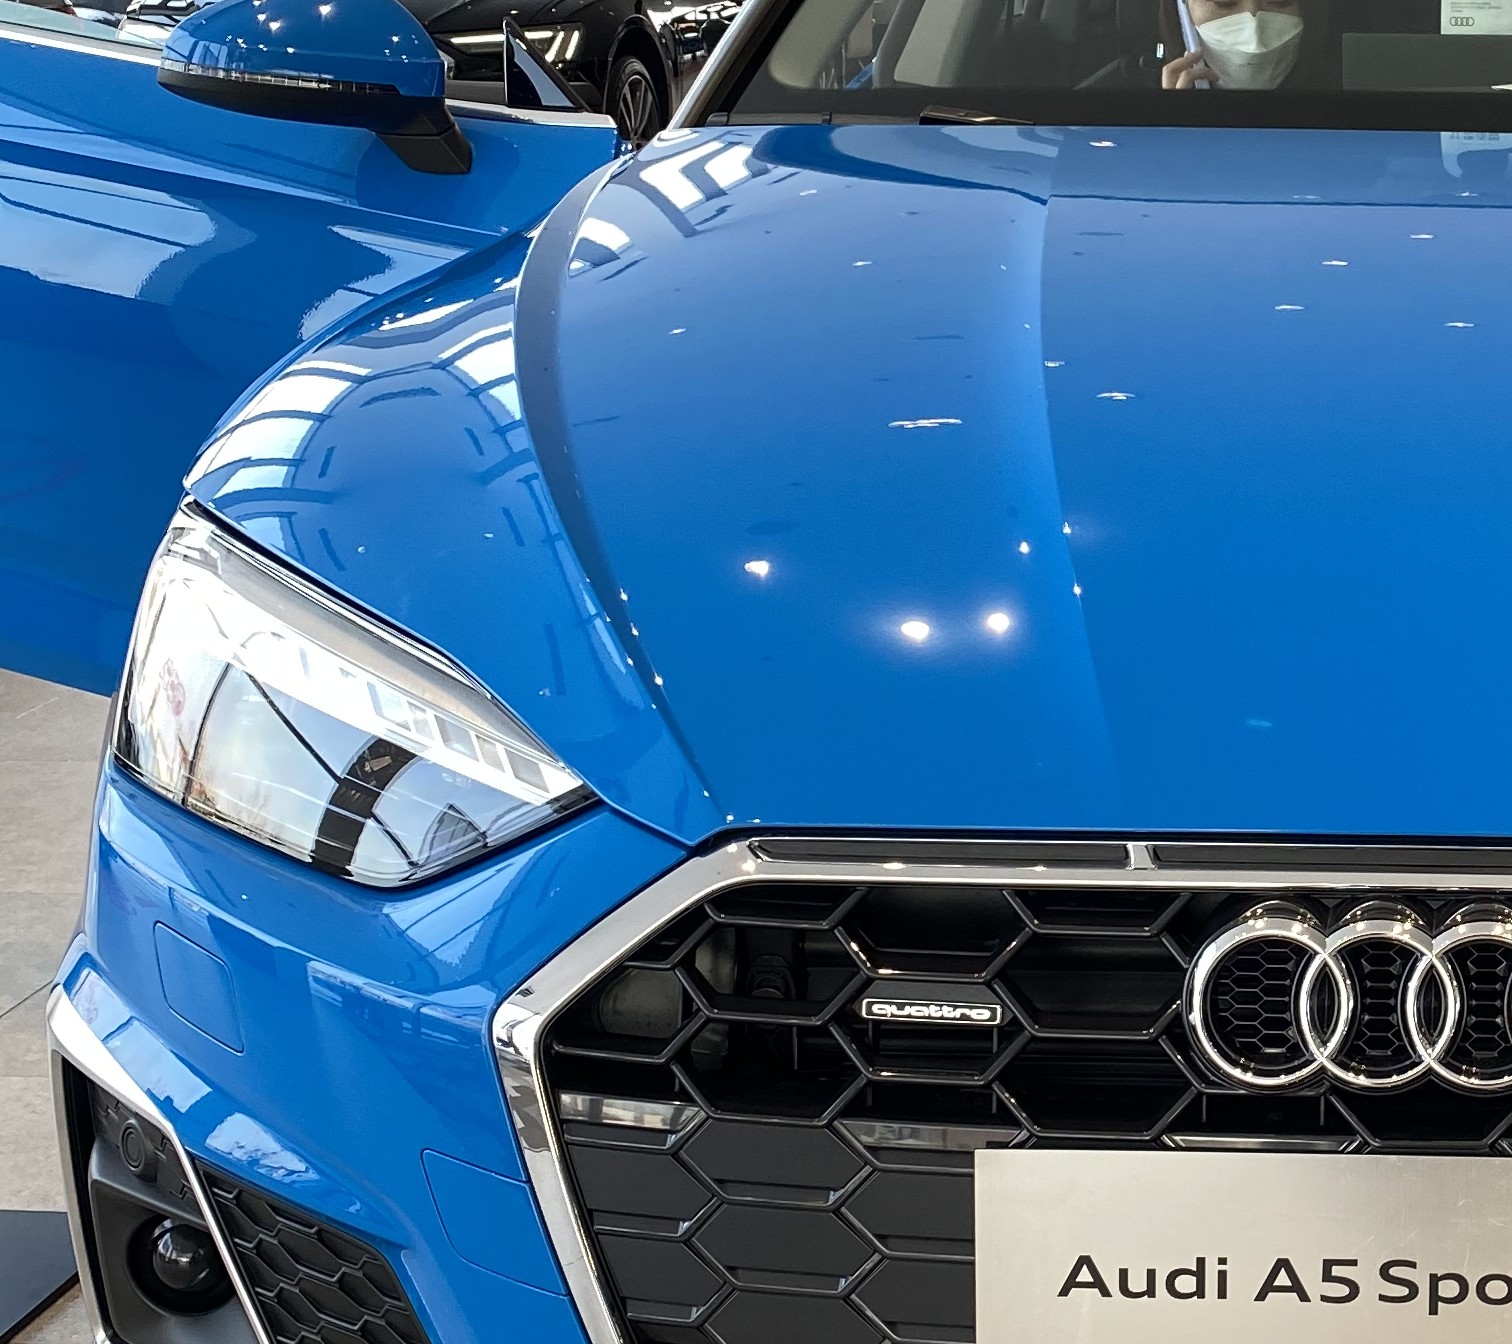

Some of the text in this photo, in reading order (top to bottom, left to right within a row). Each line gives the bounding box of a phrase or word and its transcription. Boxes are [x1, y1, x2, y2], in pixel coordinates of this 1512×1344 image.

[871, 1003, 991, 1020] quattro
[1057, 1254, 1228, 1301] Audi
[1253, 1257, 1361, 1305] A5
